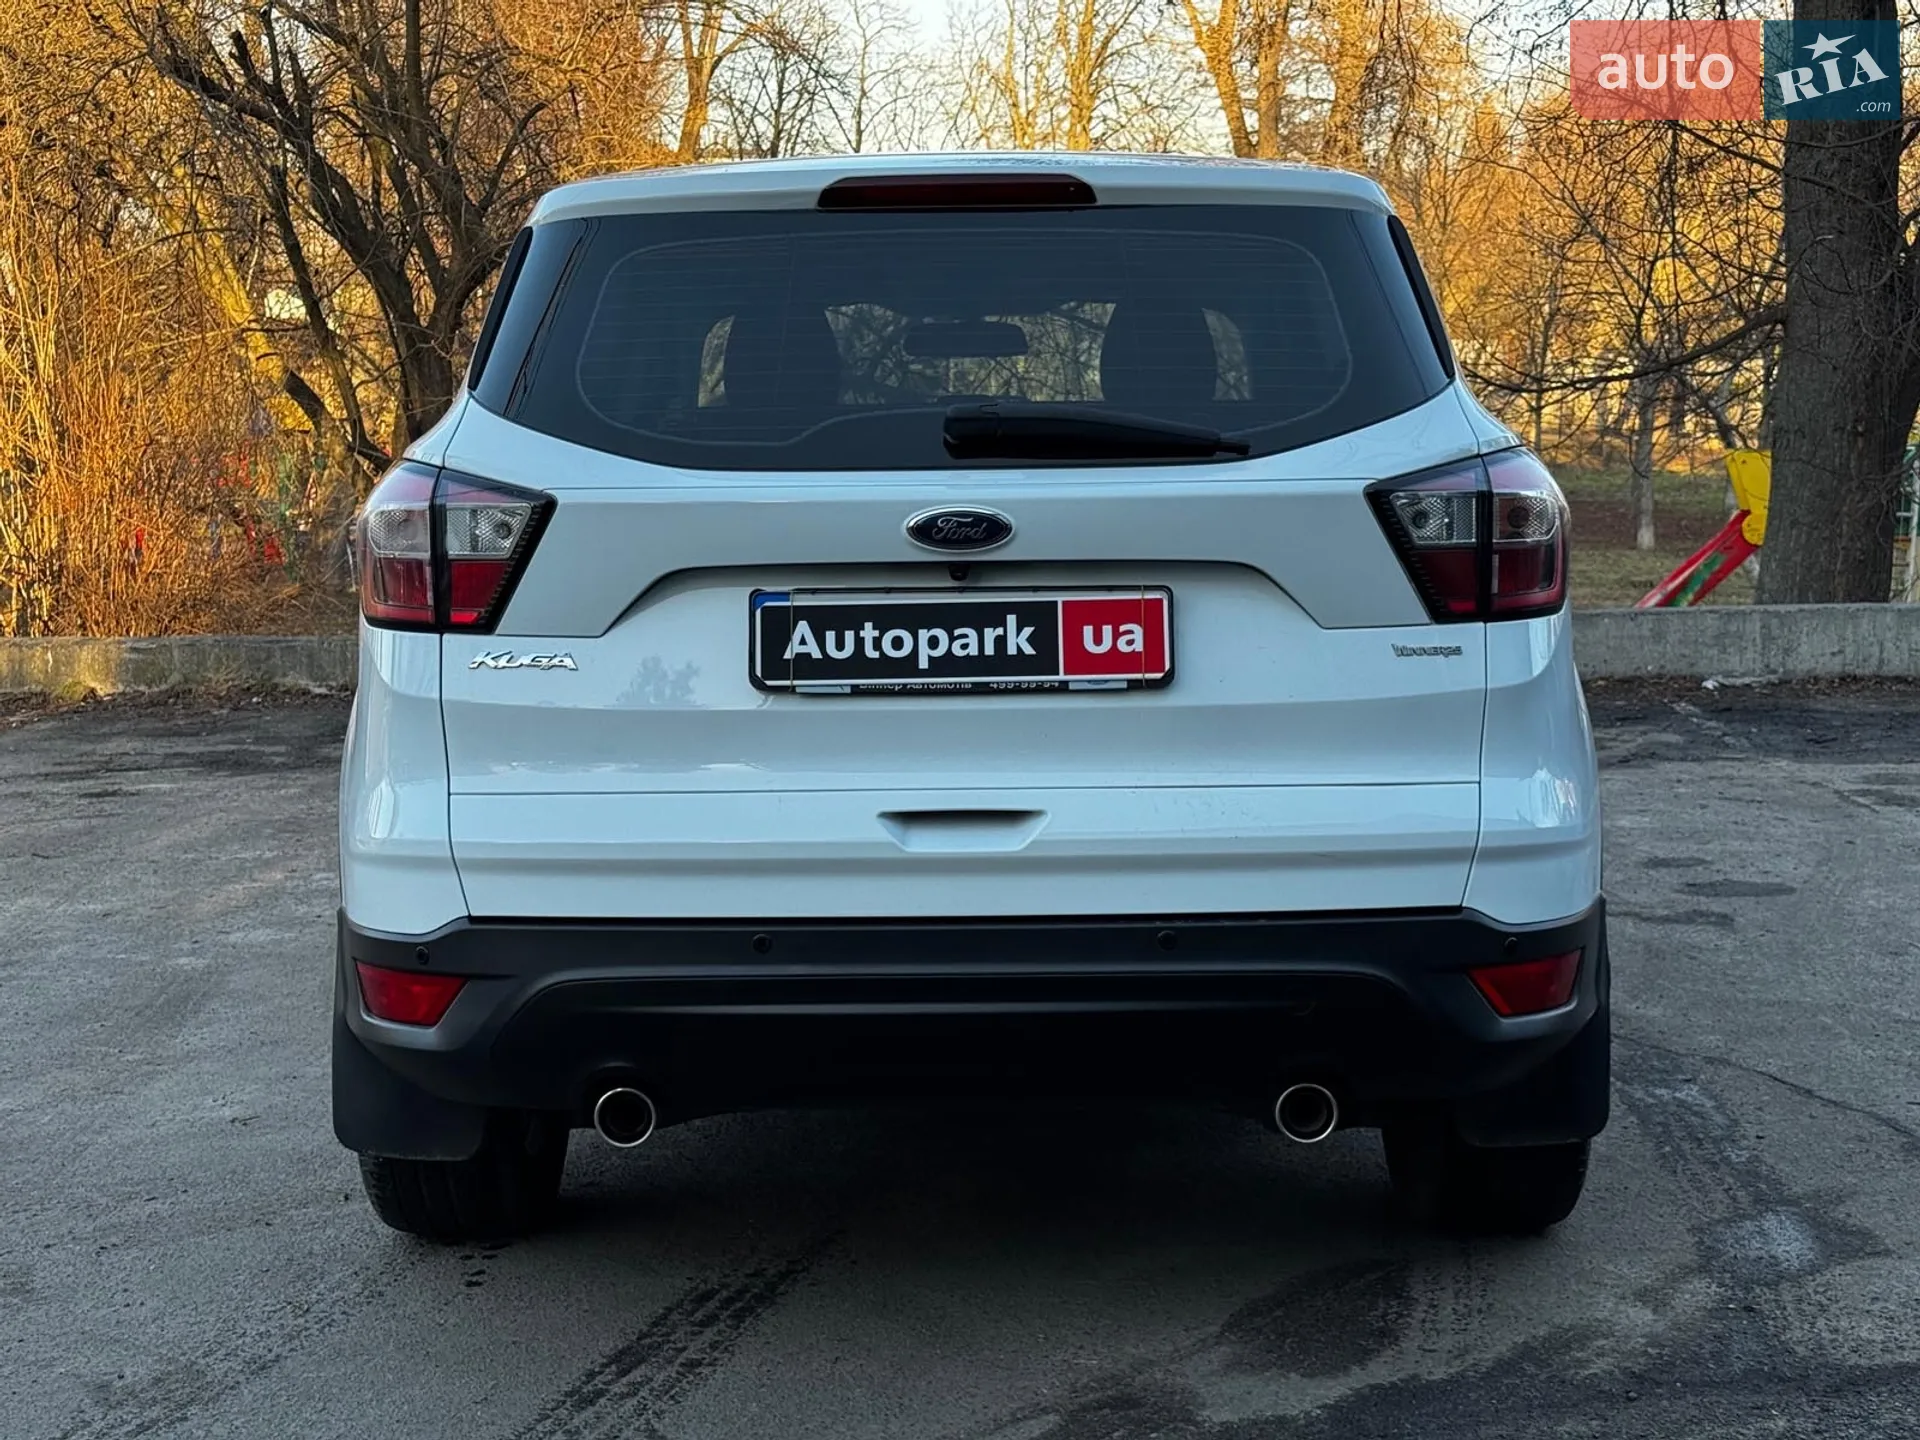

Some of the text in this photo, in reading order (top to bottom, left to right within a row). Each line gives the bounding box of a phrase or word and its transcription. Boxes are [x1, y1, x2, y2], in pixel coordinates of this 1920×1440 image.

[932, 516, 988, 540] Ford
[782, 614, 1144, 669] Autopark ua
[468, 650, 579, 671] KUGA
